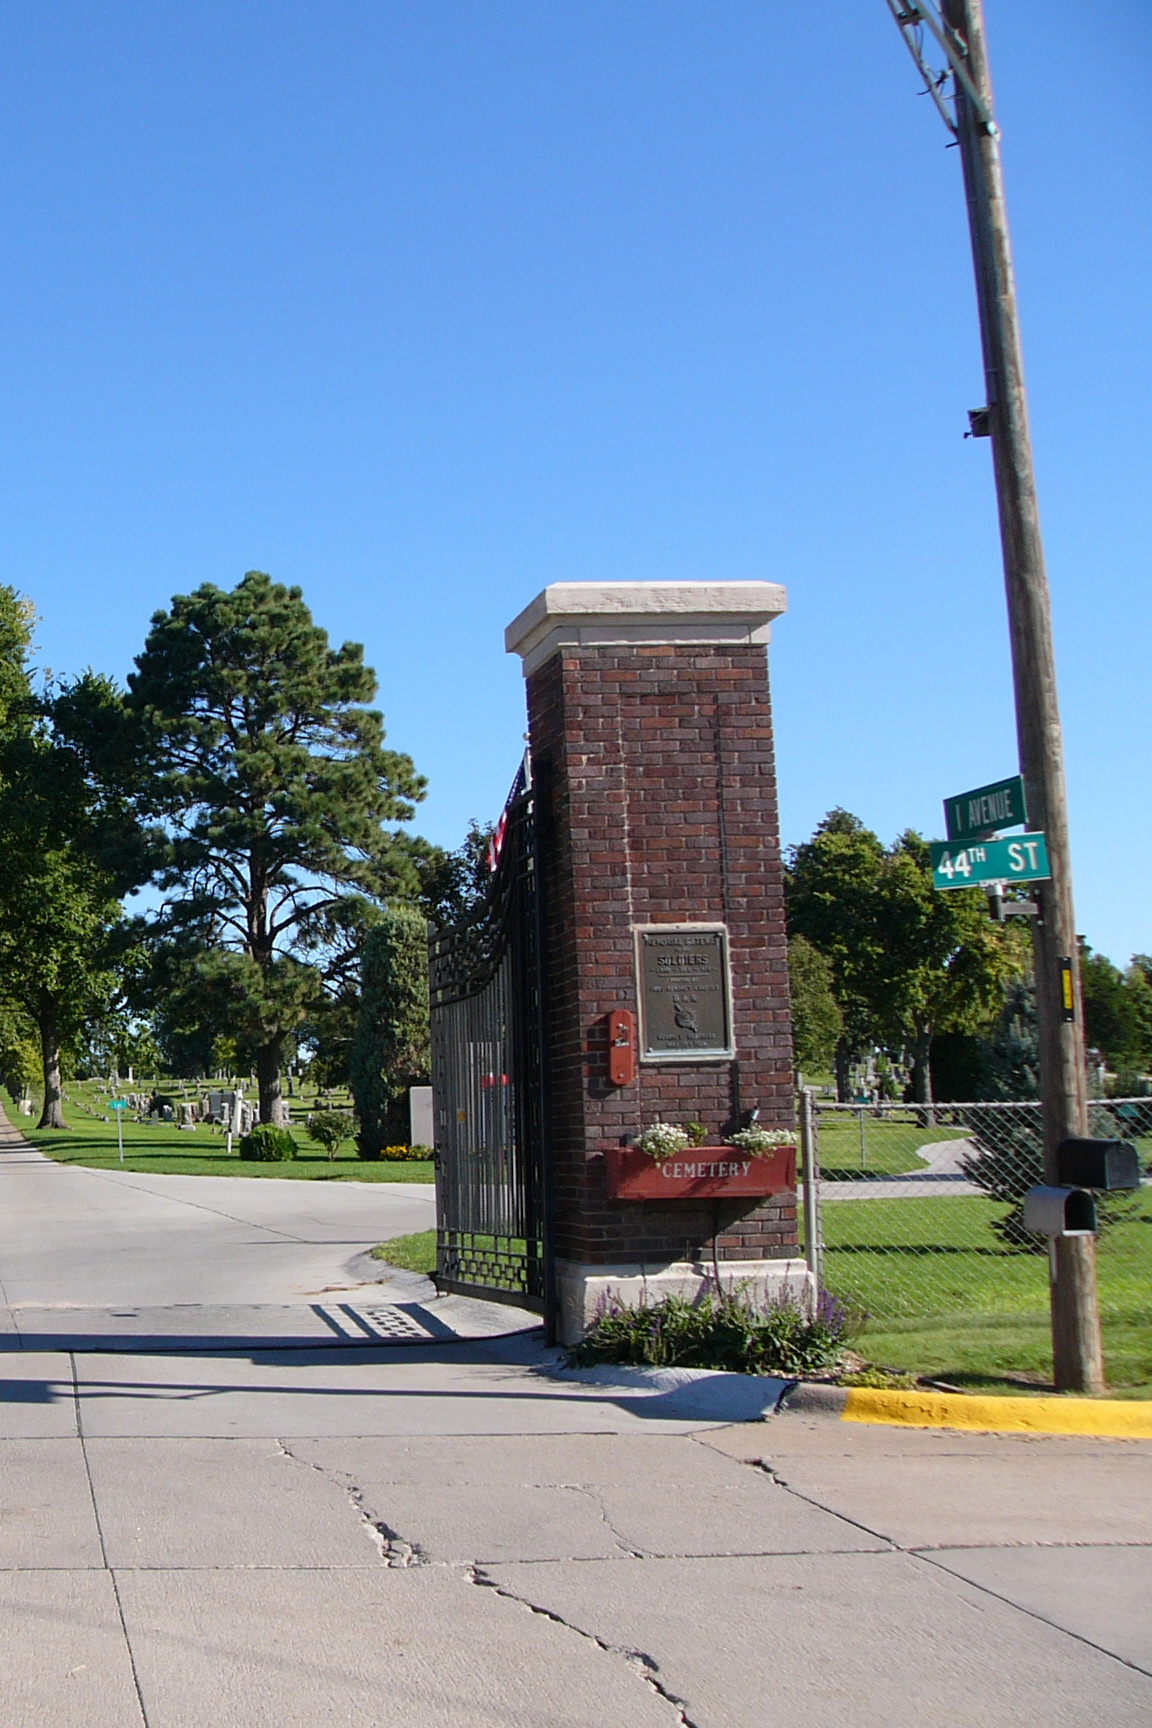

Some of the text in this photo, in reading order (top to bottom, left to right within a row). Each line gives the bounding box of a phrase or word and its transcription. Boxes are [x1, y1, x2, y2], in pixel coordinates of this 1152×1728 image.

[969, 789, 1013, 828] AVENUE
[938, 842, 1039, 879] 44TH ST
[657, 954, 708, 966] SOLDIERS
[661, 1161, 752, 1179] CEMETERY
